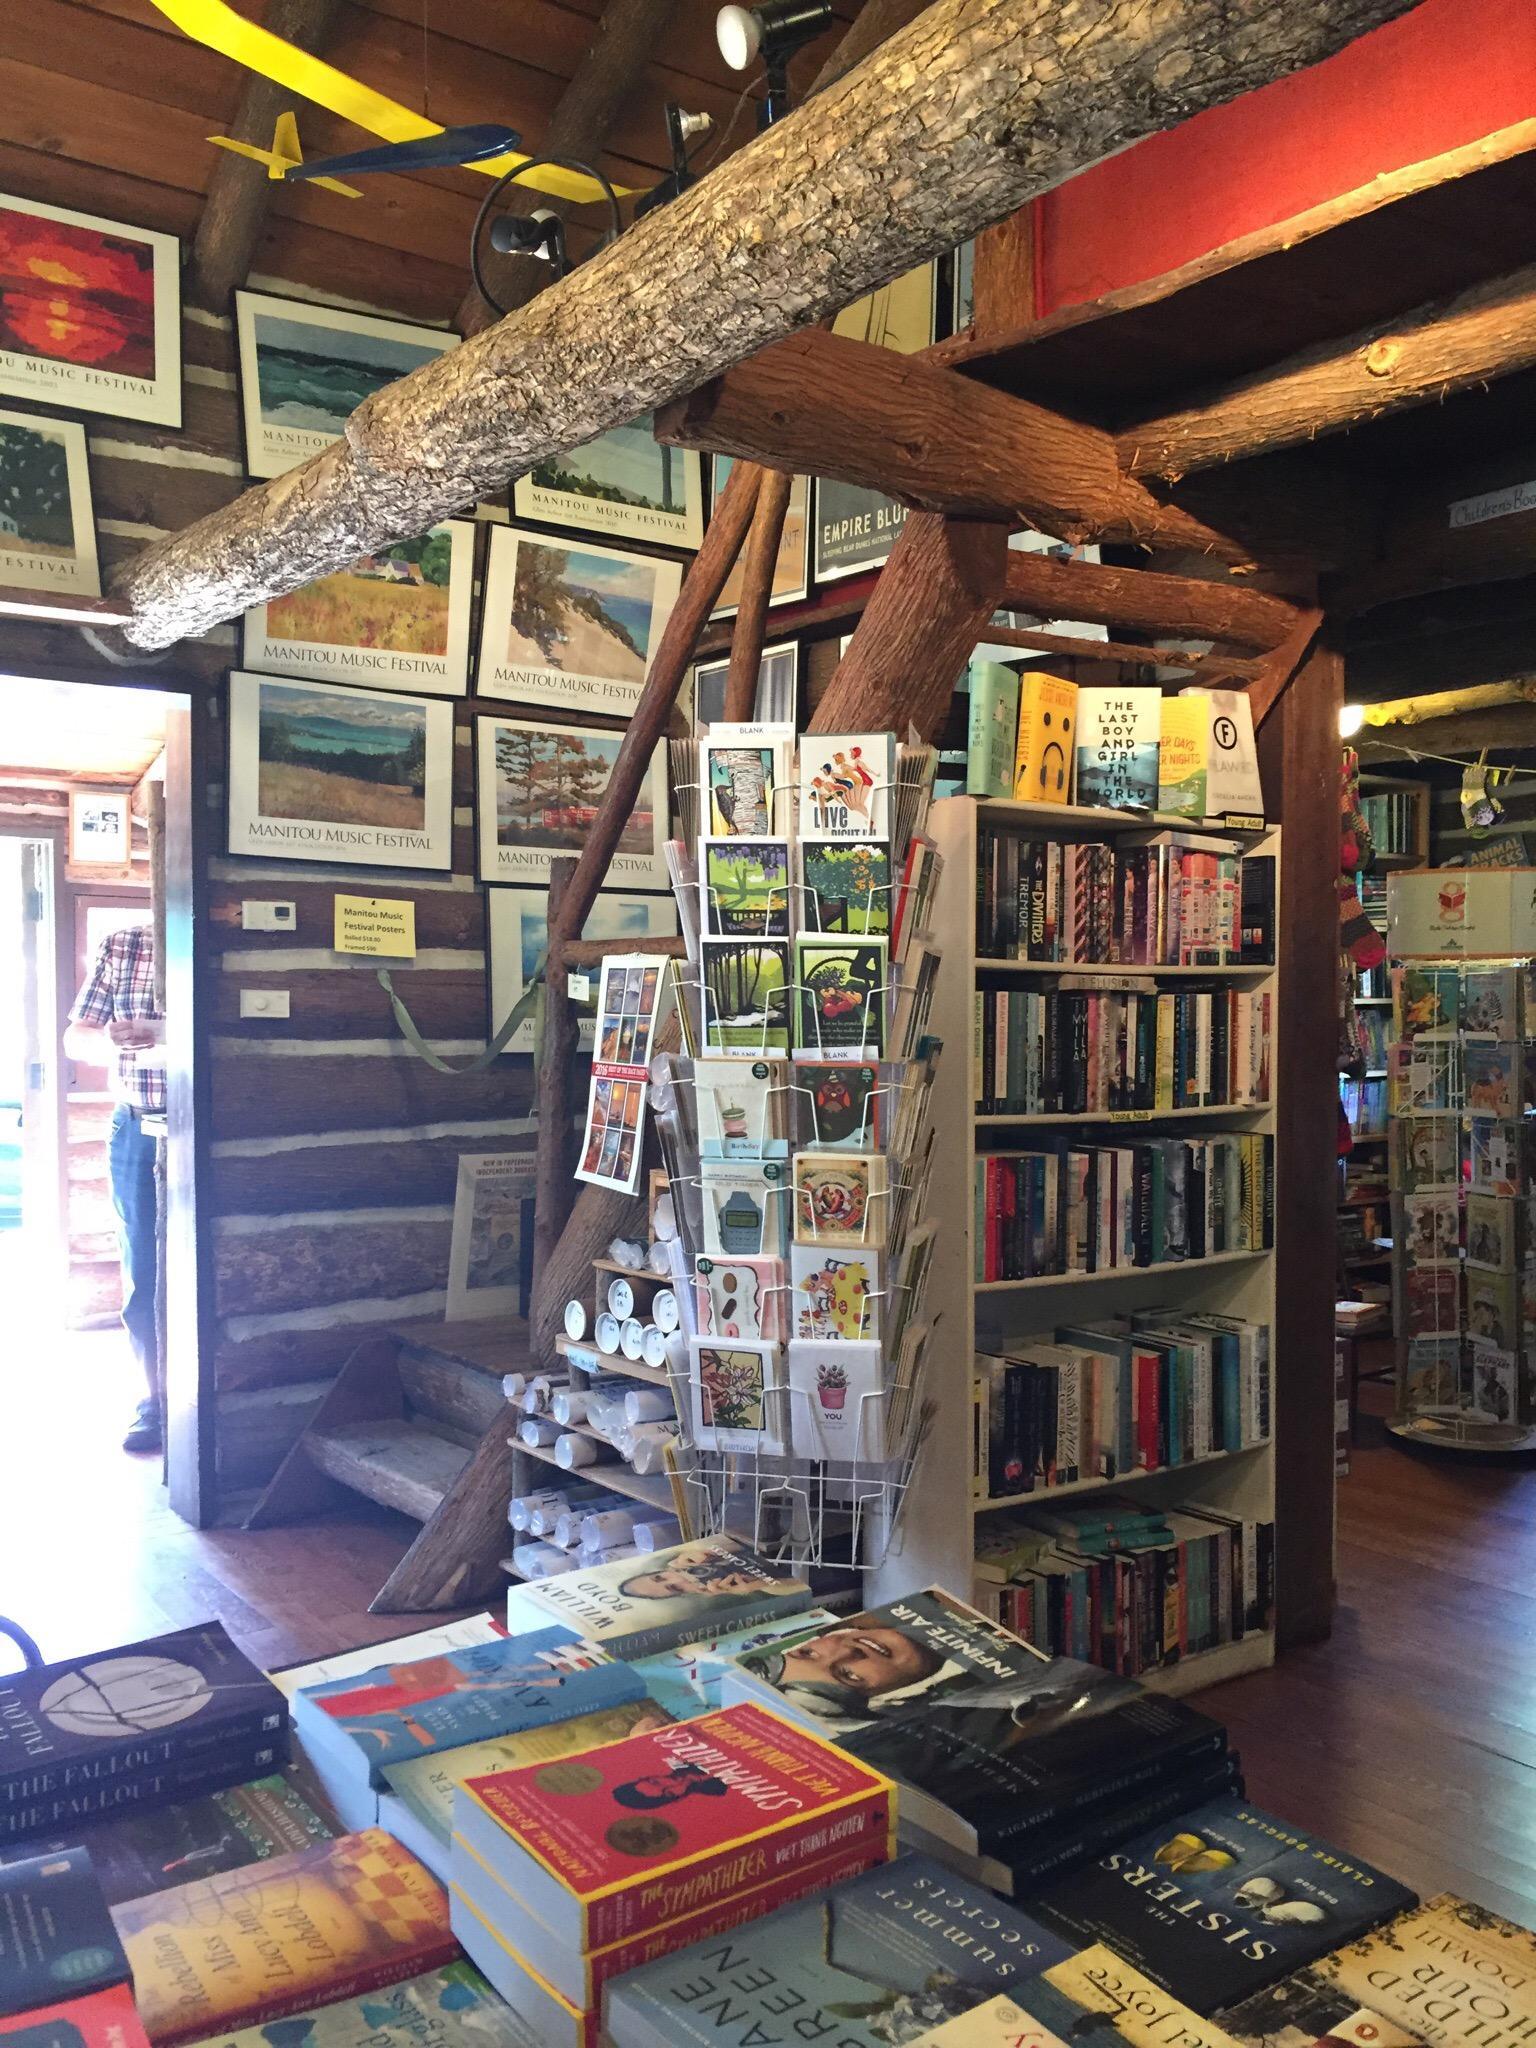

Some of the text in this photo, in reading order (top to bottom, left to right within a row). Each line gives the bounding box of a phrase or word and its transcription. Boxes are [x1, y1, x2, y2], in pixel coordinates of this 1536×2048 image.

[26, 361, 156, 396] MUSIC FESTIVAL
[263, 430, 332, 448] MANITOU
[532, 493, 590, 512] MANITOU
[595, 506, 630, 520] MUSIC
[637, 513, 687, 531] FESTIVAL
[824, 513, 872, 545] EMPIRE
[263, 645, 337, 664] MANITOU
[341, 652, 386, 669] MUSIC
[391, 657, 448, 675] FESTIVAL
[494, 667, 557, 688] MANITOU
[560, 676, 600, 694] MUSIC
[603, 683, 641, 700] FESTIV
[1098, 714, 1138, 723] LAST
[1104, 702, 1133, 711] THE
[739, 727, 764, 735] BLANK
[1101, 739, 1135, 749] AND
[1102, 726, 1134, 736] BOY
[1097, 751, 1138, 762] GIRL
[1108, 763, 1127, 774] IN
[1088, 788, 1146, 800] WORLD
[1103, 776, 1133, 786] THE
[248, 822, 322, 841] MANITOU
[325, 829, 372, 846] MUSIC
[376, 832, 432, 850] FESTIVAL
[1227, 817, 1246, 828] Young
[611, 859, 654, 872] ESTIVAL
[1470, 837, 1522, 865] ANIMAL
[344, 908, 403, 920] Manitou Music
[1019, 877, 1029, 928] TREMOR
[1032, 891, 1046, 945] DIVINERS
[344, 921, 406, 933] Festival Posters
[1111, 1112, 1130, 1121] Young
[744, 1562, 780, 1585] SWEET
[535, 1583, 614, 1629] WILLIAM
[577, 1582, 633, 1613] BOYD
[677, 1627, 723, 1647] SWEET
[725, 1609, 777, 1634] CARESS
[890, 1604, 933, 1626] AIR
[925, 1626, 1018, 1679] INFINITE
[3, 1774, 57, 1800] THE
[65, 1742, 174, 1786] FALLOUT
[652, 1727, 804, 1812] SYMPATHIZER
[793, 1773, 841, 1798] VIET
[8, 1776, 165, 1831] HE FALLOUT
[639, 1882, 665, 1909] THE
[658, 1848, 768, 1918] SYMPATHIZER
[775, 1847, 797, 1864] VIET
[830, 1811, 866, 1845] NGUYEN
[1236, 1811, 1375, 1887] CLAIRE DOUGLAS
[913, 1877, 1040, 1957] secrets
[1098, 1853, 1279, 1962] SISTERS
[1144, 1904, 1176, 1928] THE
[271, 1905, 336, 1962] Lobdell
[876, 1889, 1015, 1976] summer
[203, 1934, 241, 1973] Miss
[253, 1940, 294, 1980] Lucy
[644, 1940, 668, 1962] THE
[1415, 1930, 1527, 1990] DONATI
[153, 1932, 211, 2004] Rebellion
[1088, 1966, 1183, 2028] Joyce
[1367, 1969, 1520, 2048] ILDED
[1412, 1963, 1536, 2040] HOUR
[1408, 2016, 1448, 2041] the
